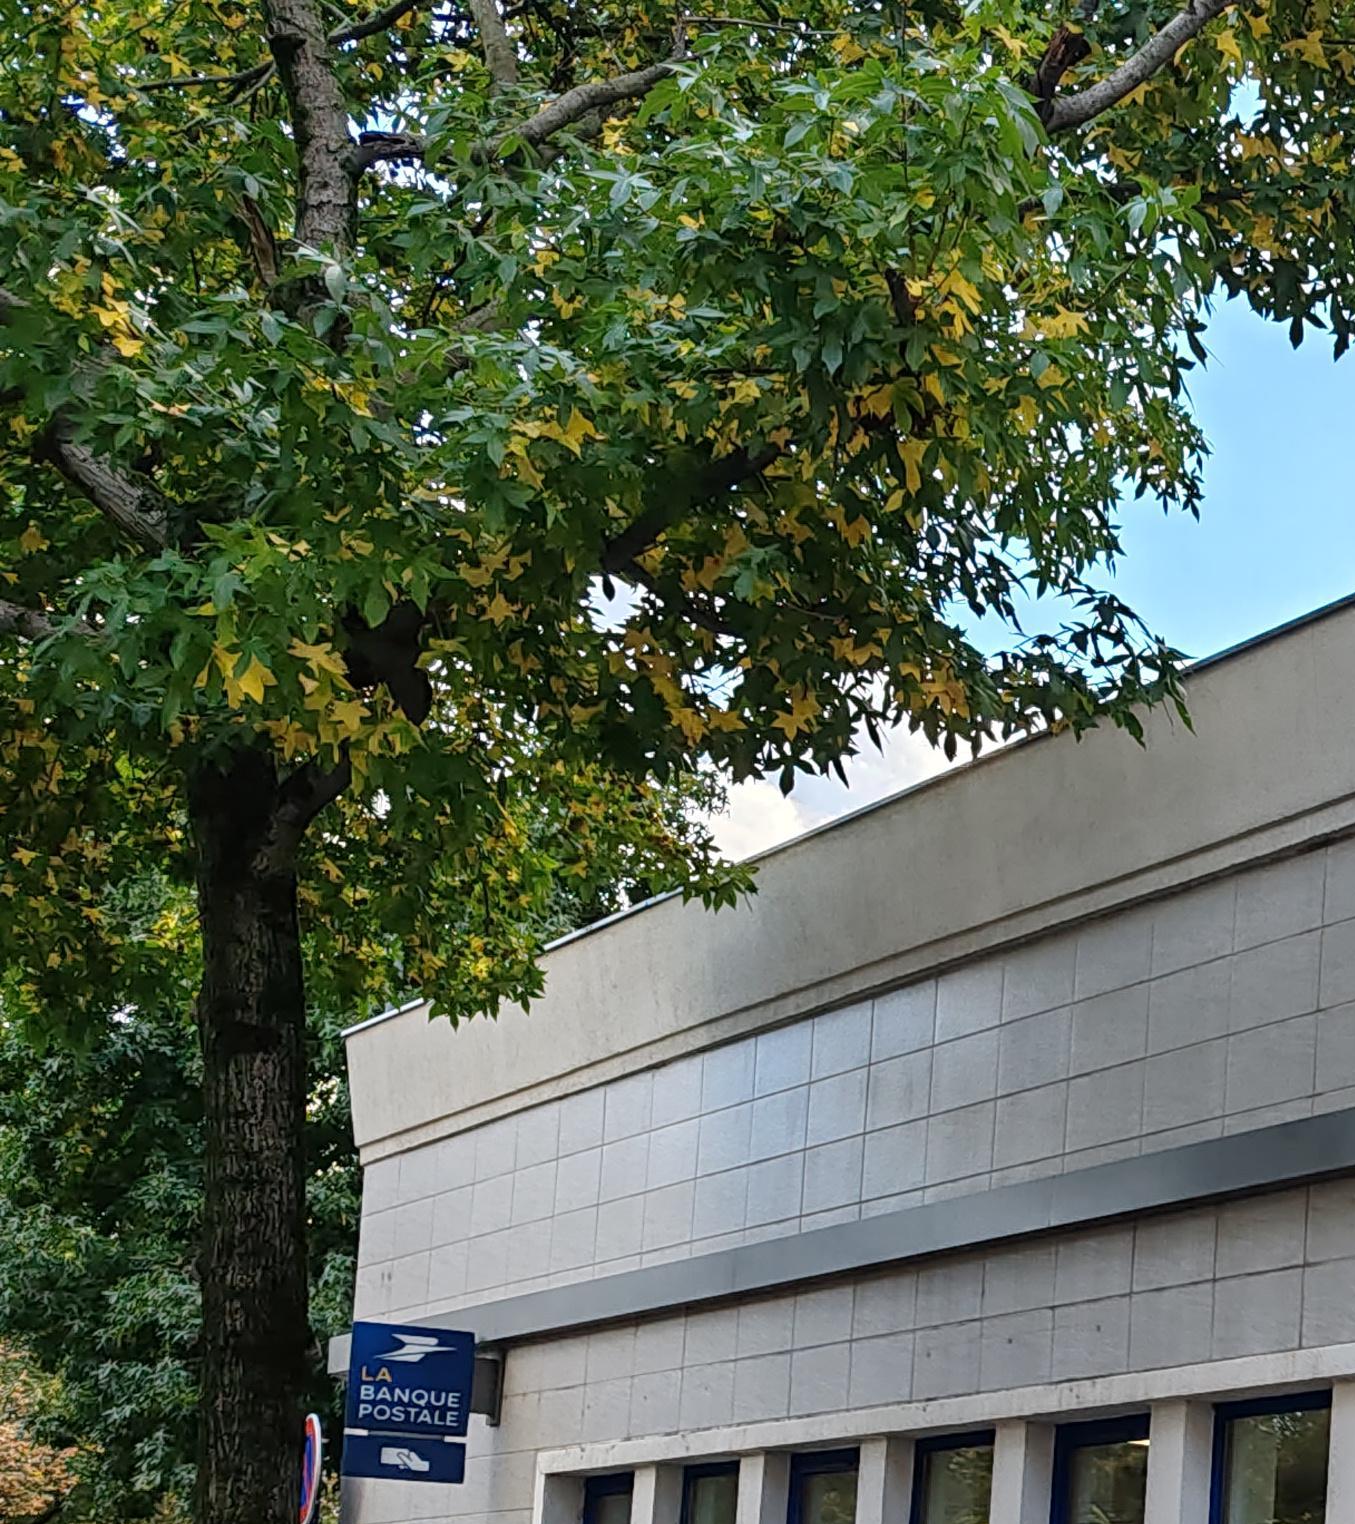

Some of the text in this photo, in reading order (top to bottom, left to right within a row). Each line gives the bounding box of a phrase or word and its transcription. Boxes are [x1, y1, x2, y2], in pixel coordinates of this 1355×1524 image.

[361, 1366, 392, 1382] LA
[360, 1385, 461, 1408] BANQUE
[358, 1404, 459, 1427] POSTALE
